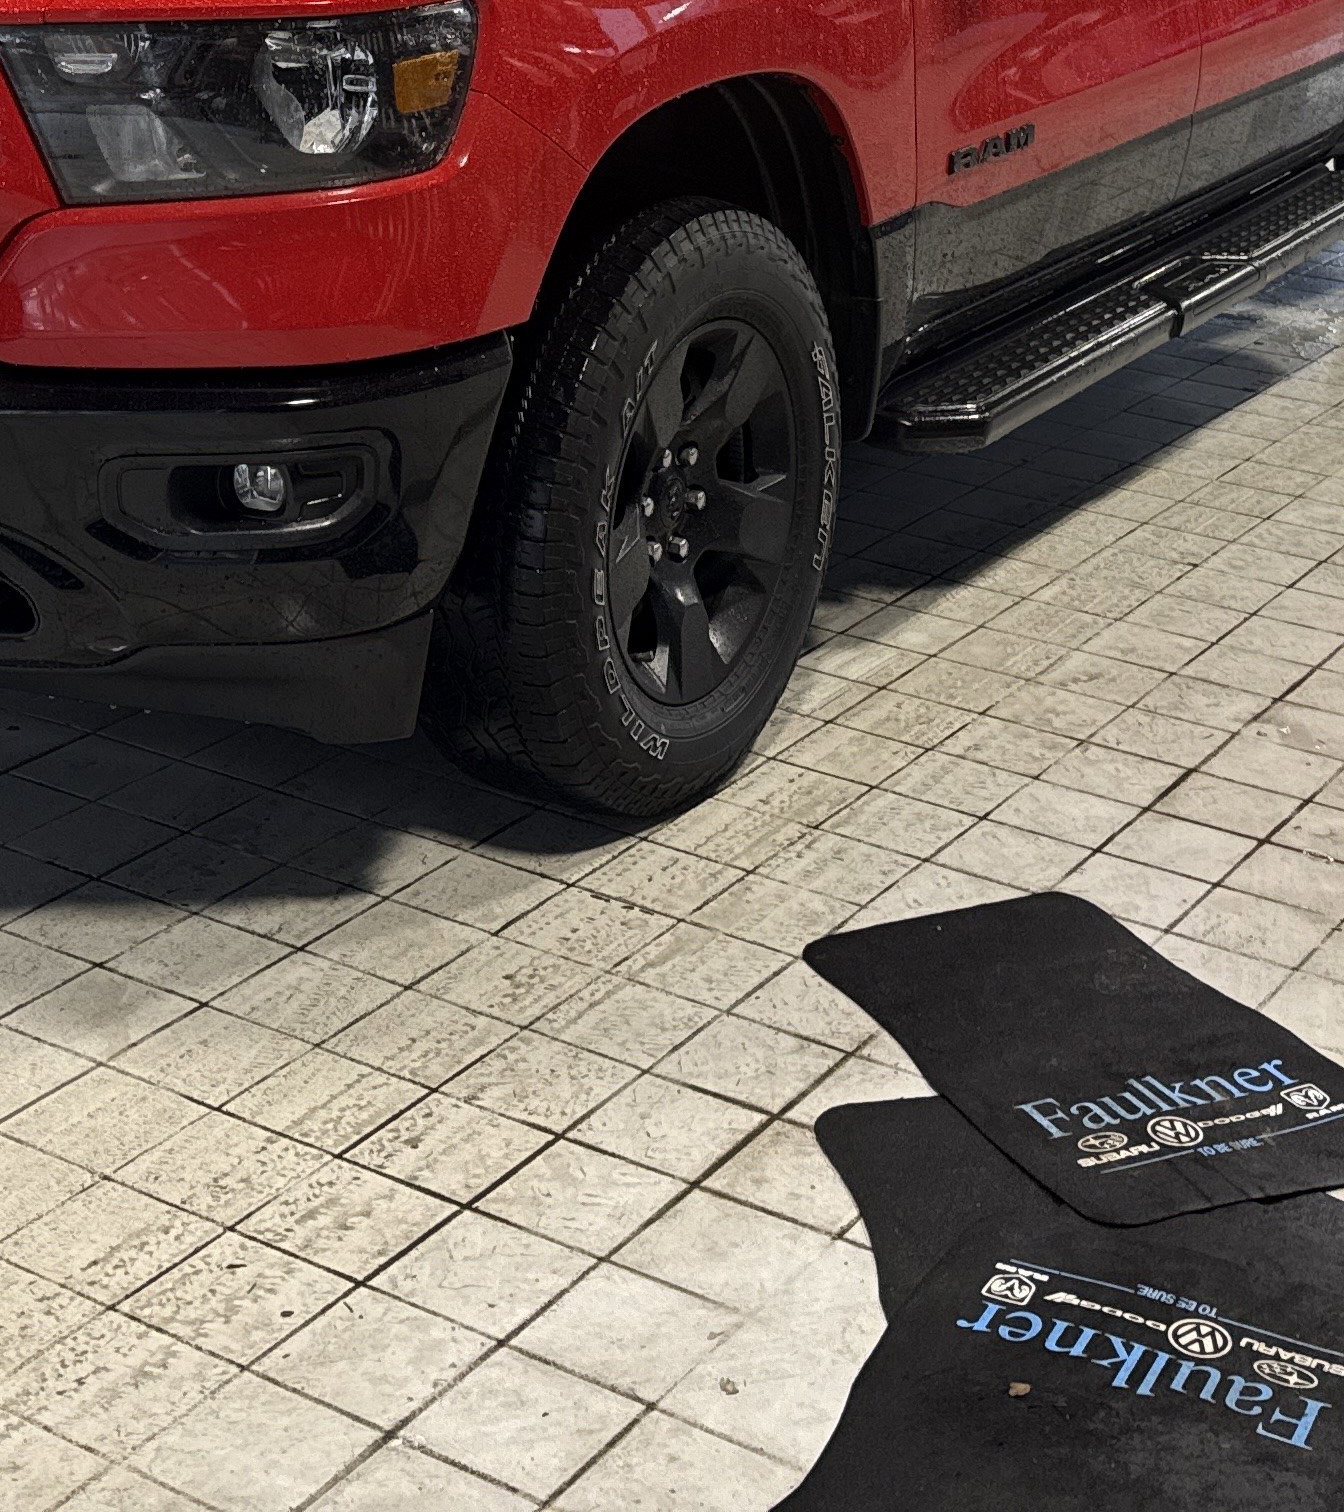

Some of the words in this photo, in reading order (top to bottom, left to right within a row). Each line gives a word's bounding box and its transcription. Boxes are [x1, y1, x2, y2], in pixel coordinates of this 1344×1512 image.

[946, 121, 1036, 176] RAM
[1014, 1058, 1299, 1139] Faulkner
[1077, 1142, 1160, 1168] SUBARU
[995, 1262, 1049, 1282] RAM
[1198, 1303, 1218, 1318] TO
[956, 1300, 1332, 1451] Faulkner
